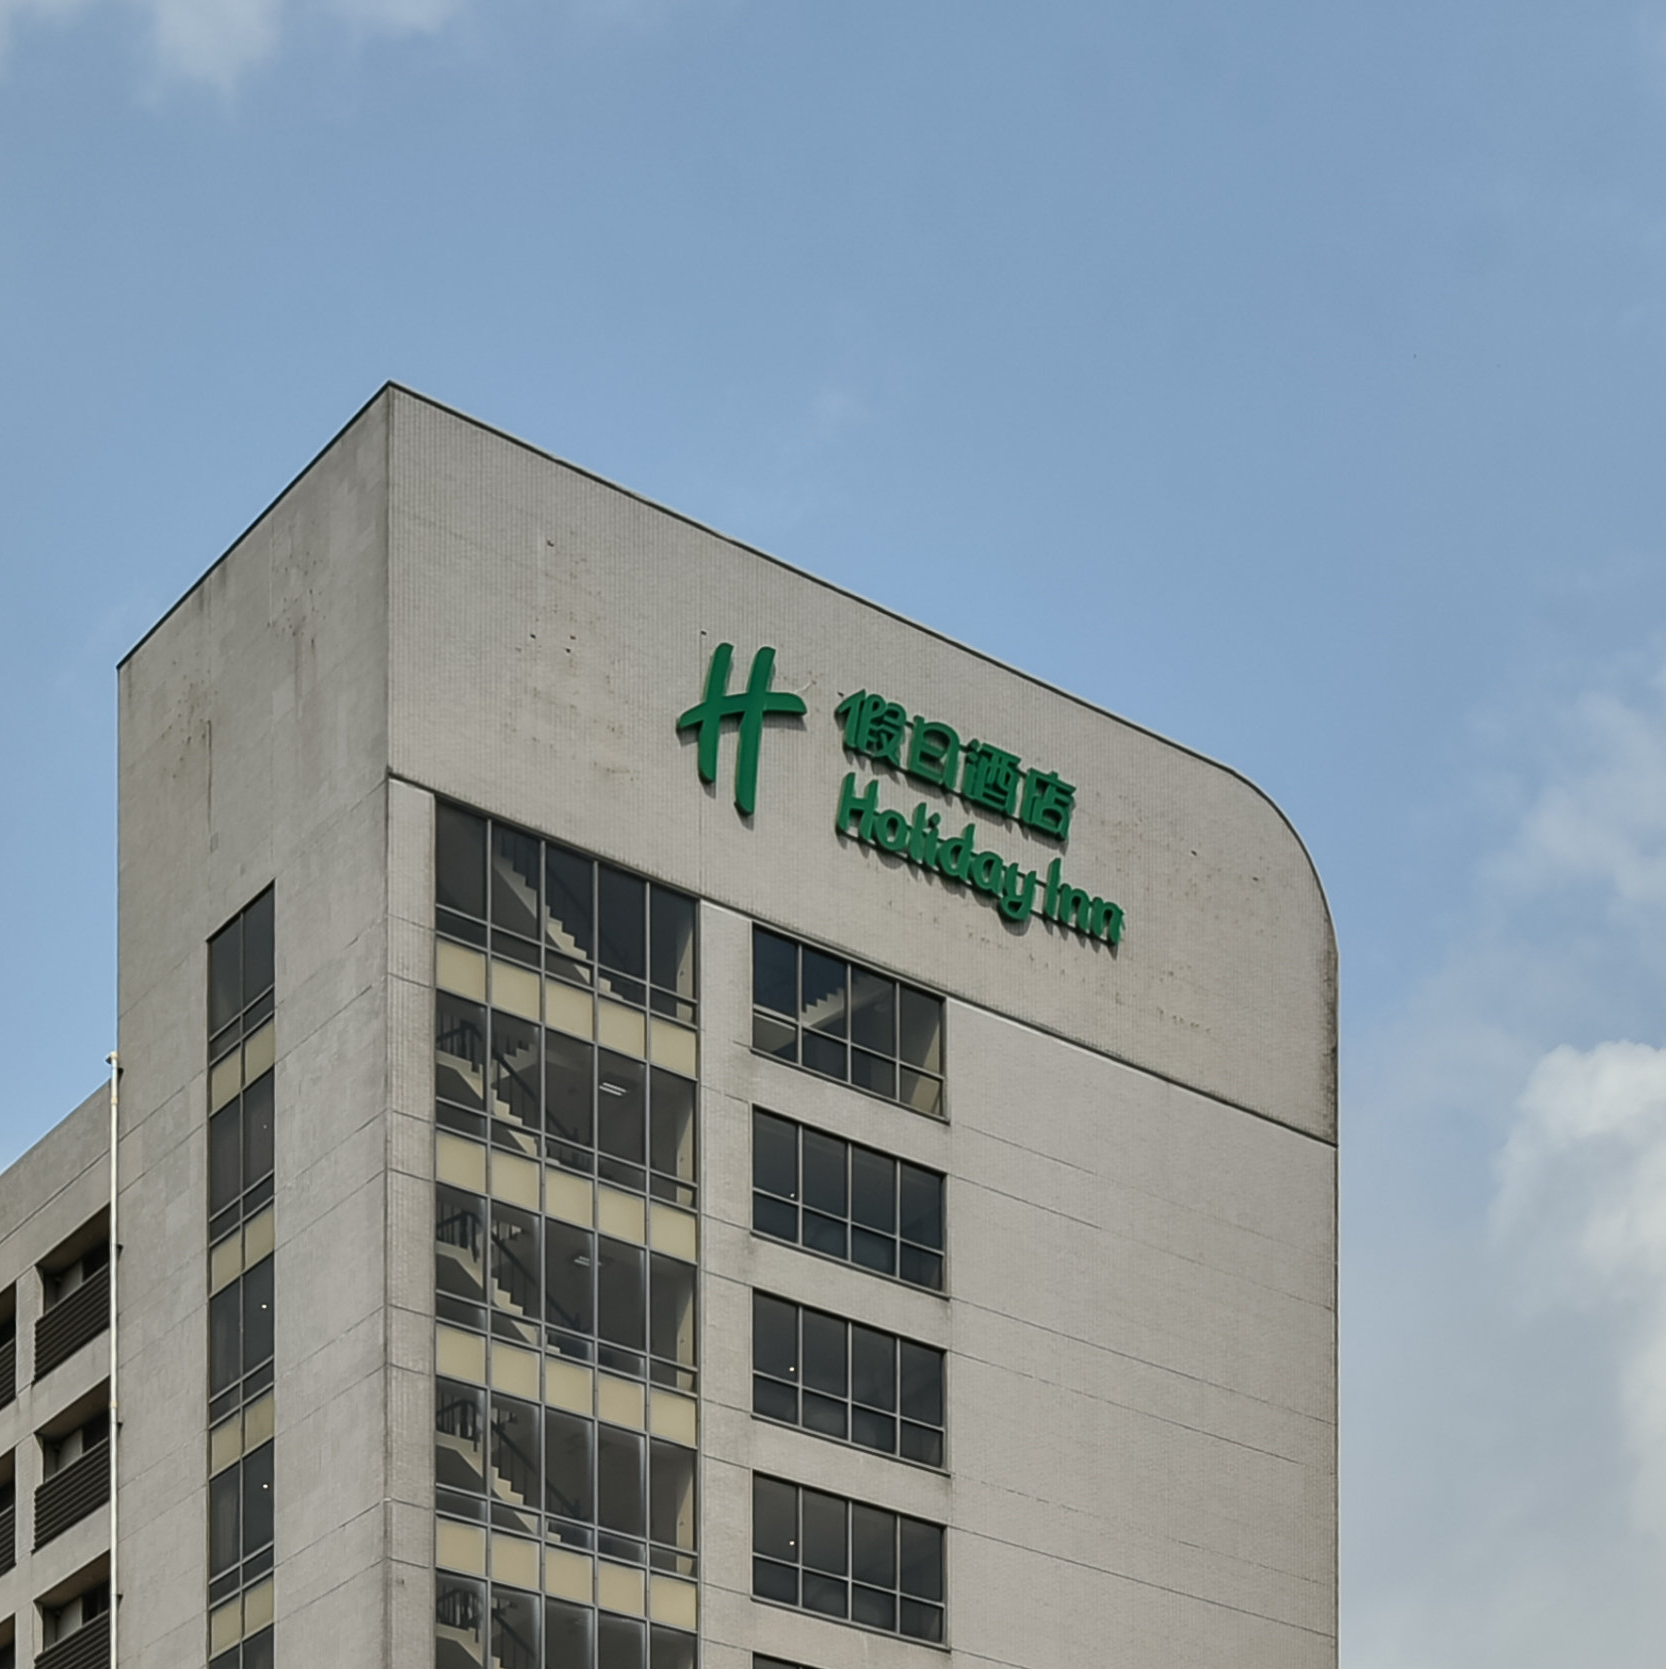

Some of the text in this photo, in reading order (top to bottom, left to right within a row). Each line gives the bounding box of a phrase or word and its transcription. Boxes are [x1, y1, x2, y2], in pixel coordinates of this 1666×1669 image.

[834, 689, 1076, 842] 假日酒店
[836, 772, 1123, 946] Holiday Inn
